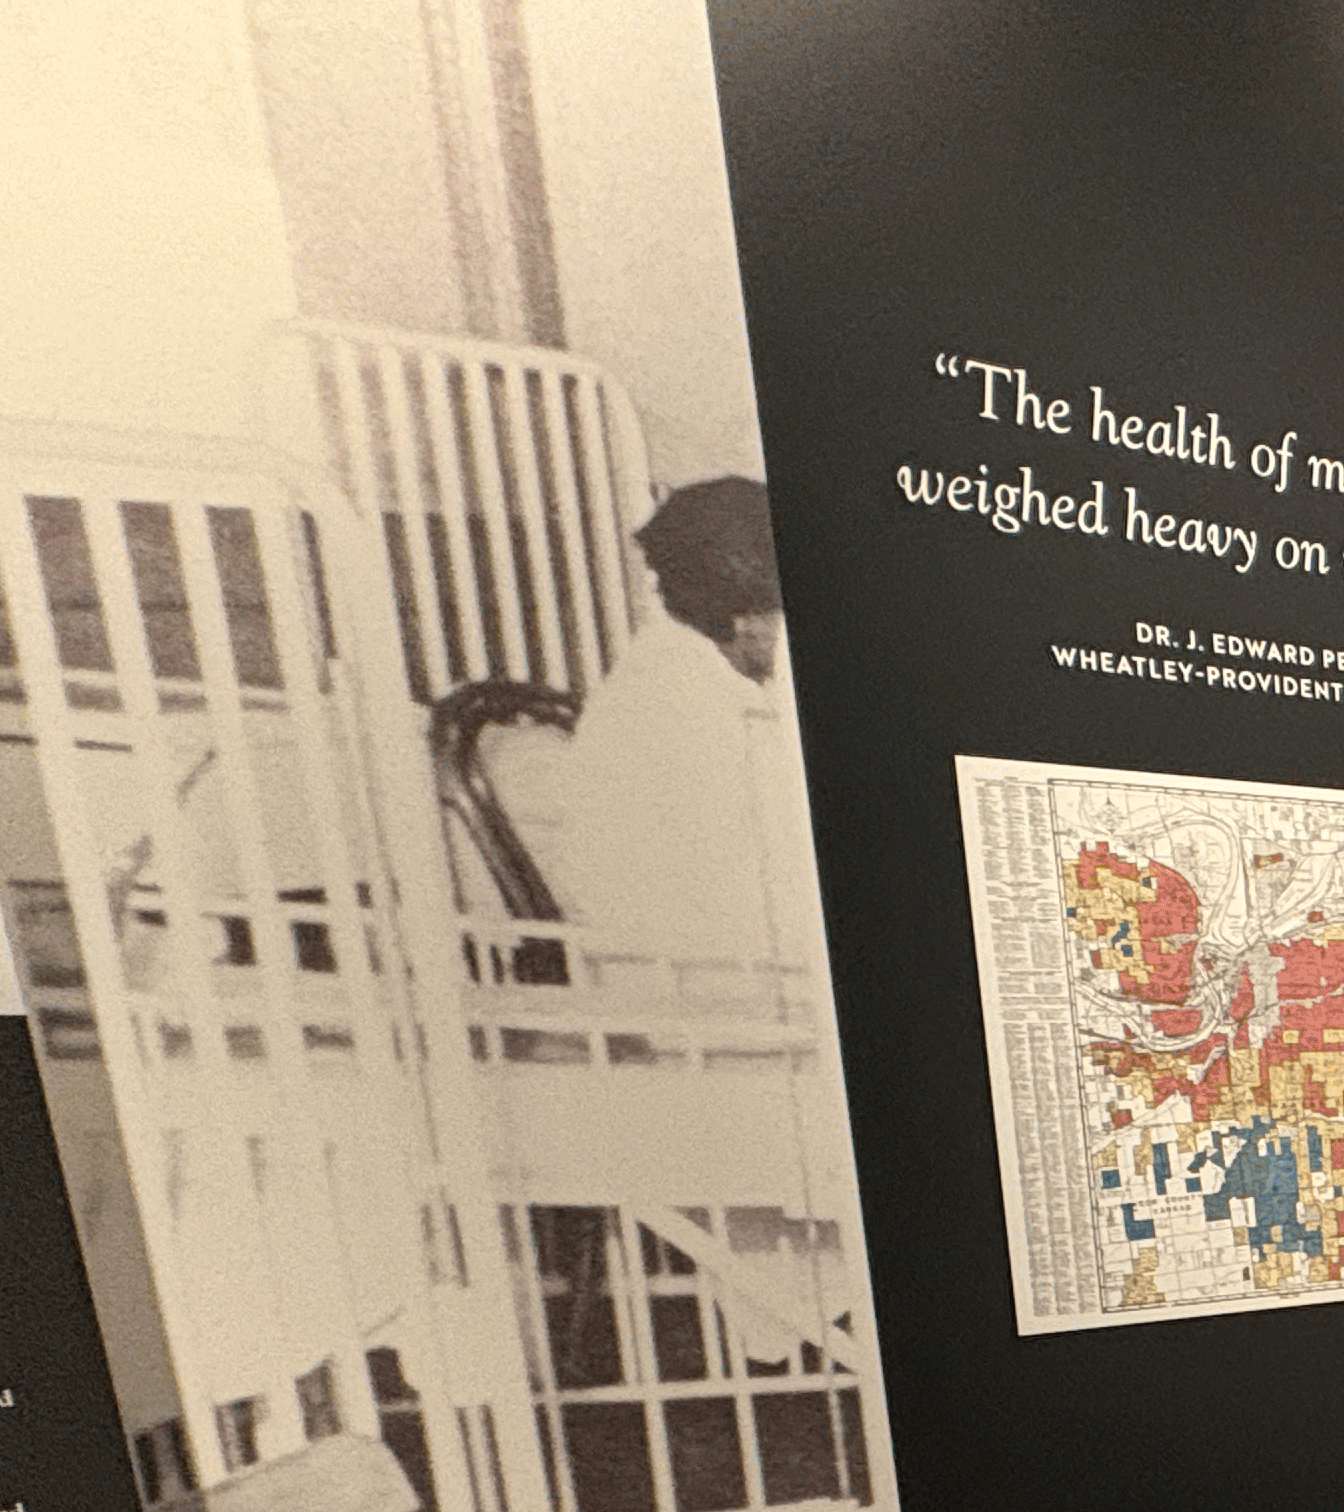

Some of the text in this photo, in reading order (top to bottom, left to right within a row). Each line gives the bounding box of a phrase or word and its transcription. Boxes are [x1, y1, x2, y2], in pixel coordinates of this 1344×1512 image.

[935, 352, 1072, 435] “The
[1090, 386, 1236, 470] health
[1250, 431, 1298, 493] of
[897, 465, 1109, 535] weighed
[1124, 487, 1258, 574] heavy
[1275, 536, 1330, 575] on
[1052, 645, 1344, 702] WHEATLEY-PROVIDENT
[1135, 621, 1180, 648] DR.
[1187, 630, 1205, 652] J.
[1213, 633, 1316, 667] EDWARD
